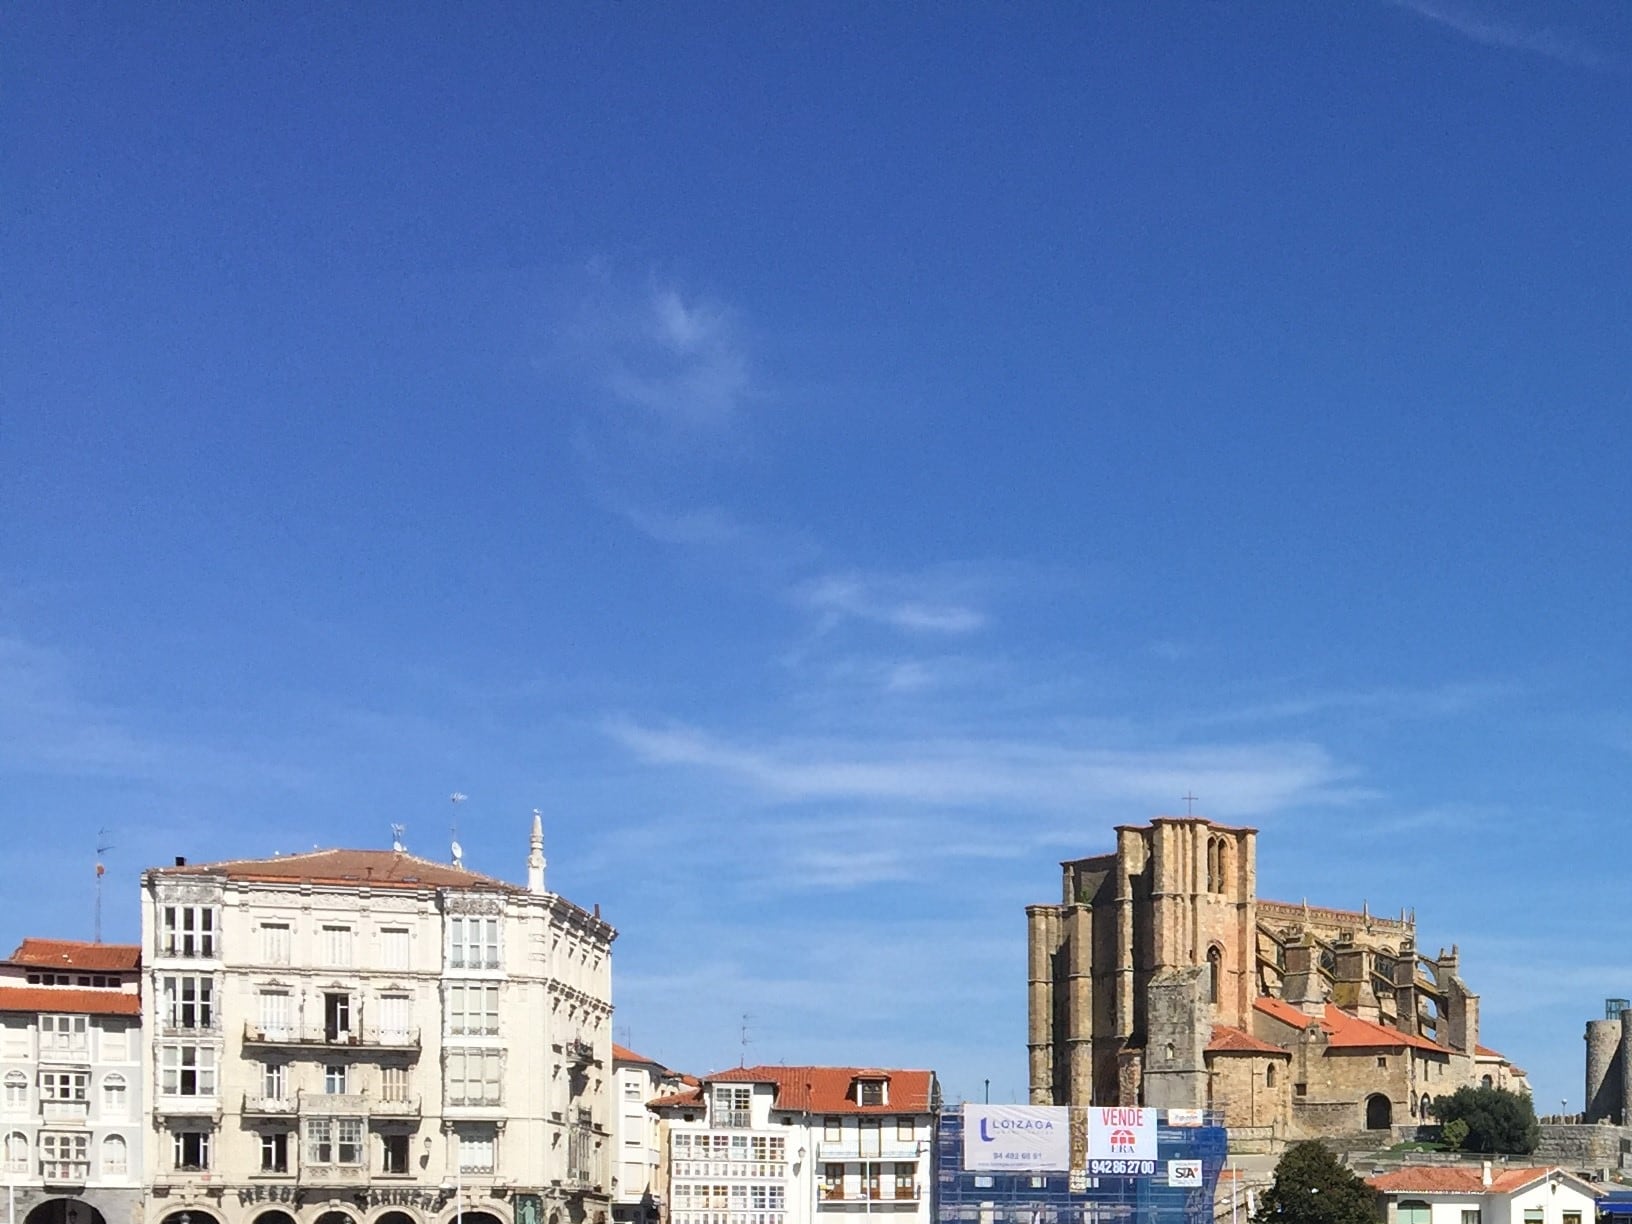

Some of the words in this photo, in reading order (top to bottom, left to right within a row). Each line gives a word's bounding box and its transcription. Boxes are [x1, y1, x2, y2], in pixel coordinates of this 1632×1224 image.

[1102, 1108, 1144, 1126] VENDE
[992, 1119, 1054, 1130] LOIZAGA
[1111, 1145, 1135, 1153] ERA
